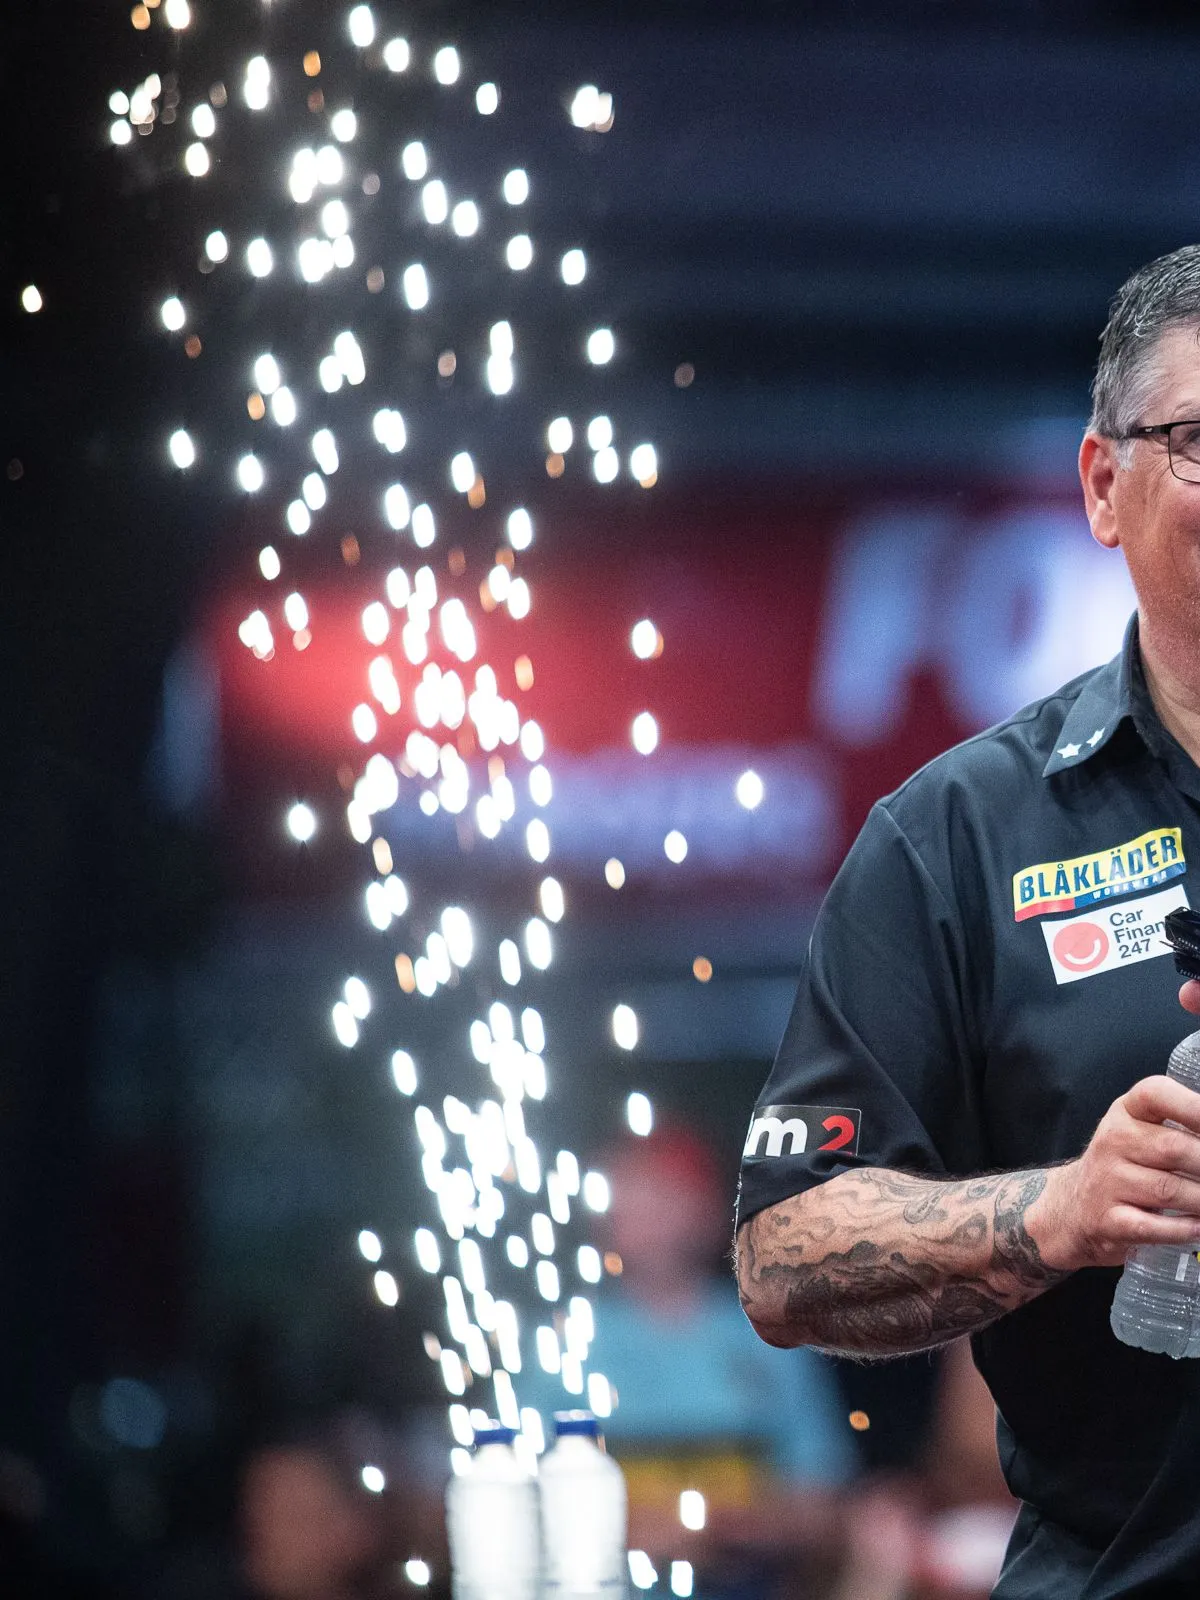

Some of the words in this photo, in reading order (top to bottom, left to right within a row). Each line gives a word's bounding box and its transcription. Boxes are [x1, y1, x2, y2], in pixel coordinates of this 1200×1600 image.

[1019, 835, 1178, 904] BLÅKLÄDER
[1093, 870, 1167, 899] WORKWEAR
[1109, 908, 1144, 927] Car
[1113, 920, 1166, 944] Finan
[1118, 938, 1151, 959] 247
